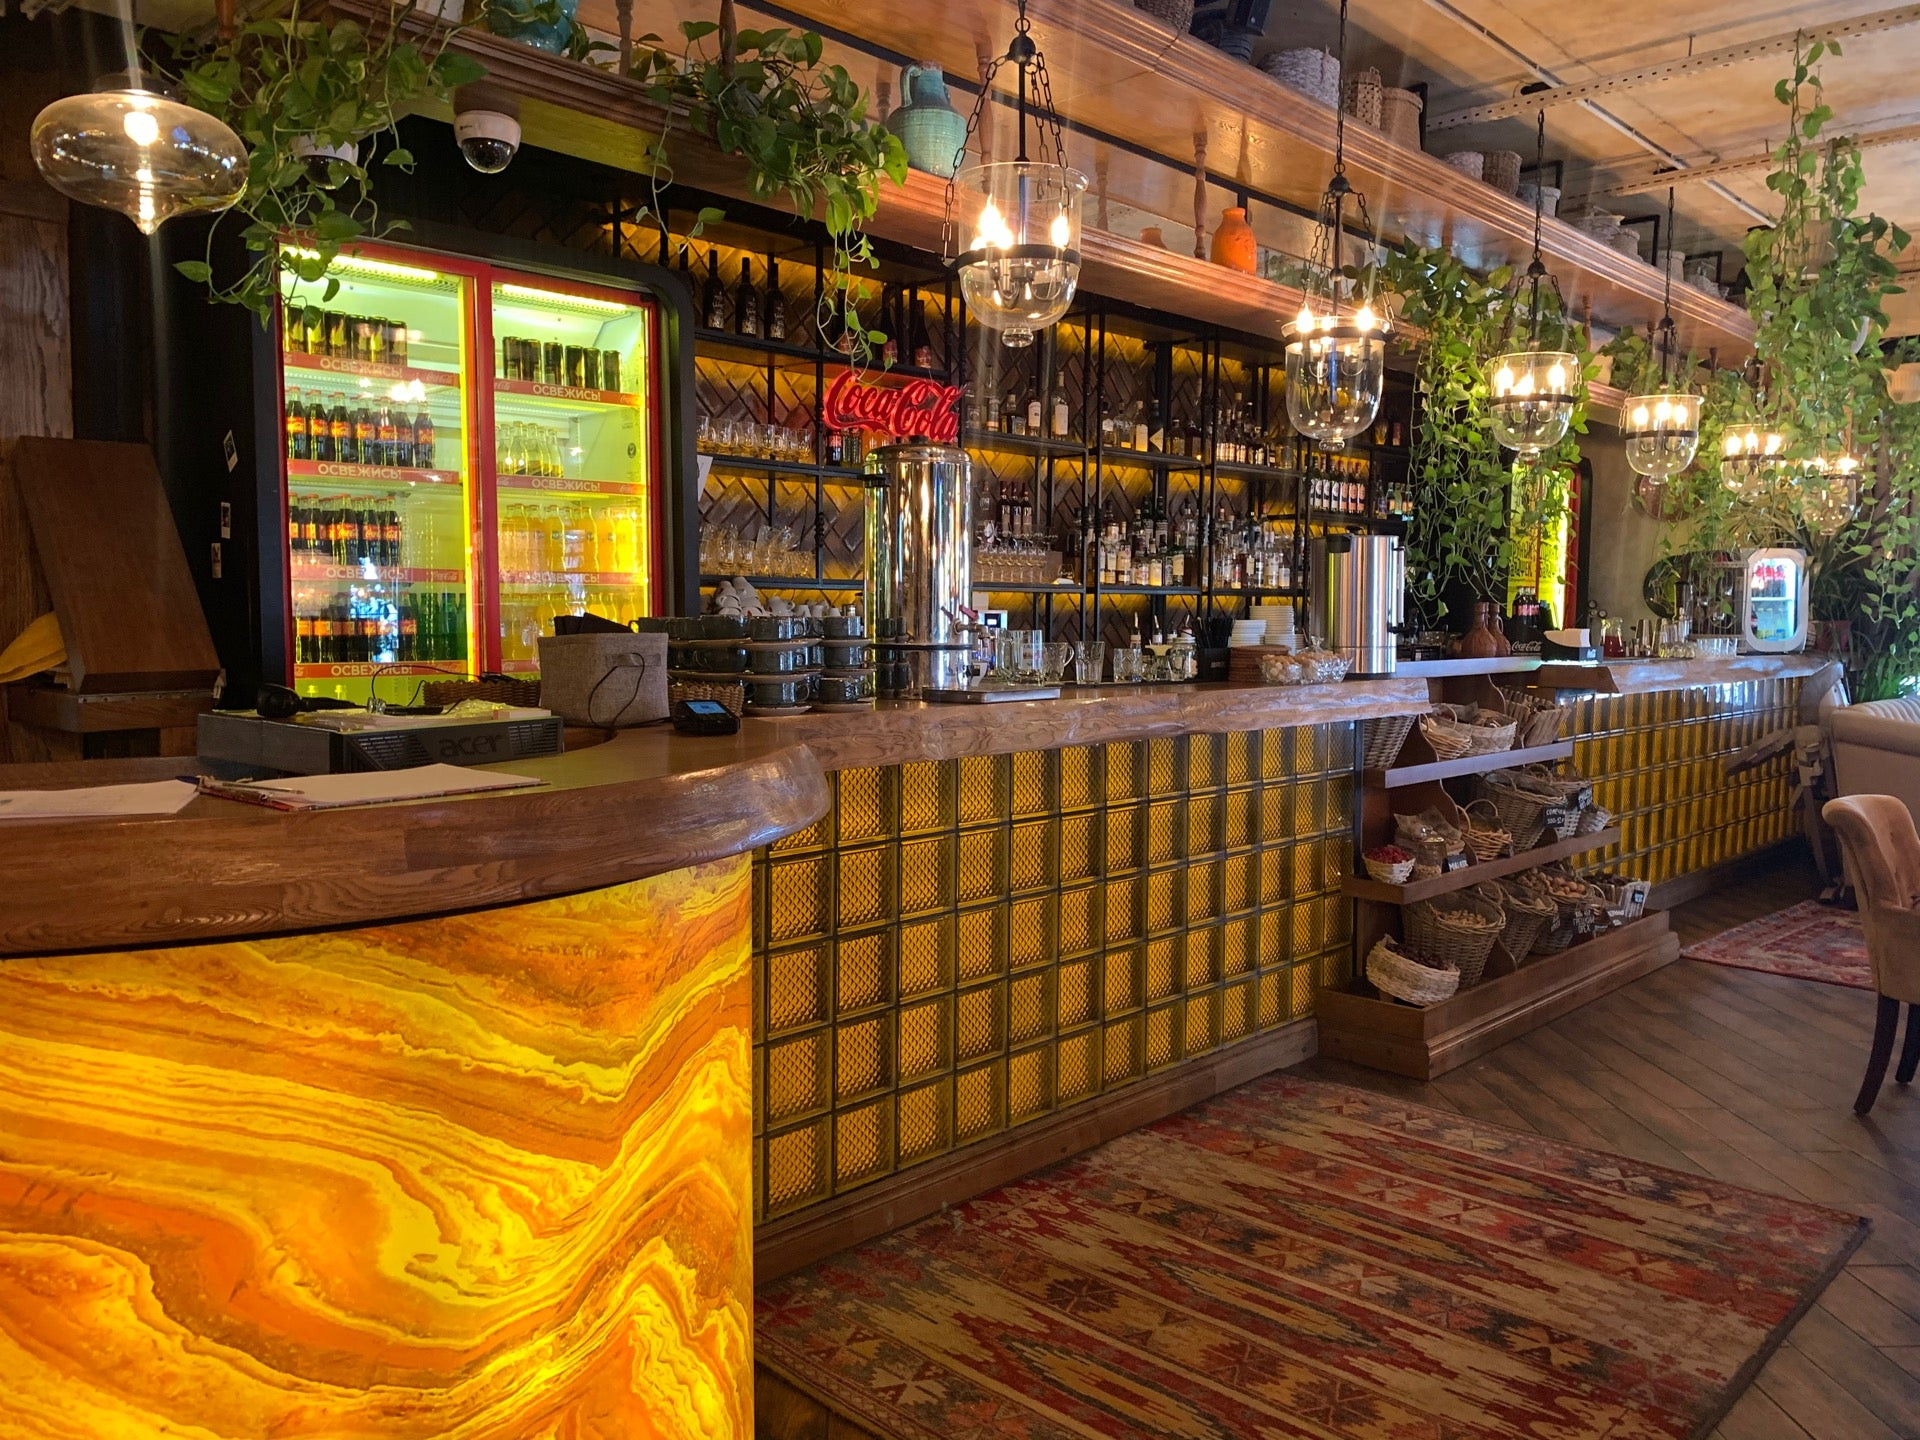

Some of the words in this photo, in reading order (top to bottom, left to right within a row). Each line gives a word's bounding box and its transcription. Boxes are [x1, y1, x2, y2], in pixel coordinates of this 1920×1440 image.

[320, 357, 403, 379] ОСВЕЖИСЬ!
[532, 384, 601, 402] ОСВЕЖИСЬ!
[317, 463, 402, 481] ОСВЕЖИСЬ!
[531, 477, 601, 492] ОСВЕЖИСЬ!
[326, 566, 409, 581] ОСВЕИСЬ!
[330, 664, 413, 677] ОСВЕЖИСЬ!
[438, 733, 503, 758] acer
